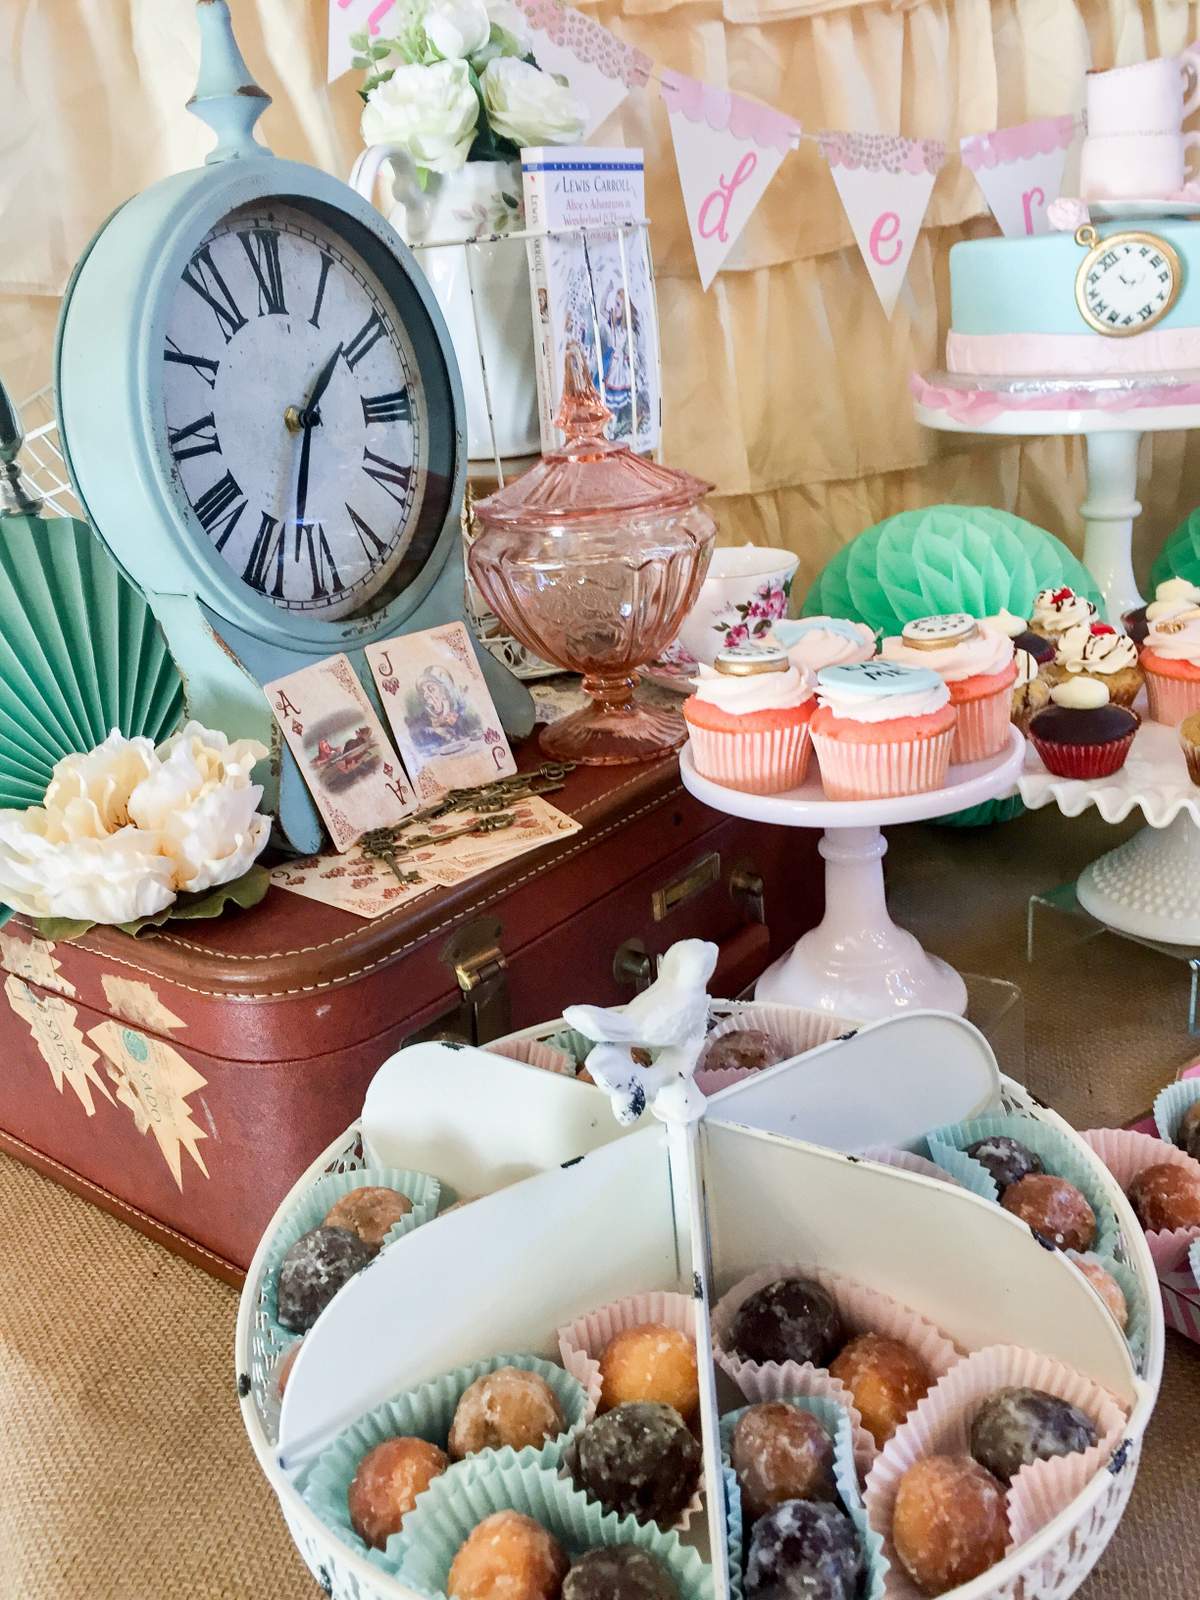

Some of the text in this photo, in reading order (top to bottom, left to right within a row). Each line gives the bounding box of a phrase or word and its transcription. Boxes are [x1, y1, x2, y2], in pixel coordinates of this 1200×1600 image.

[562, 175, 630, 193] LEWIS CARROLL
[181, 245, 250, 345] XI
[236, 230, 290, 318] XII
[307, 250, 336, 330] I
[163, 335, 220, 390] X
[341, 306, 390, 373] II
[360, 386, 413, 429] III
[168, 411, 222, 462] IX
[344, 501, 388, 566] V
[378, 650, 393, 678] J
[275, 690, 302, 720] A
[491, 745, 506, 772] J
[384, 780, 408, 807] A
